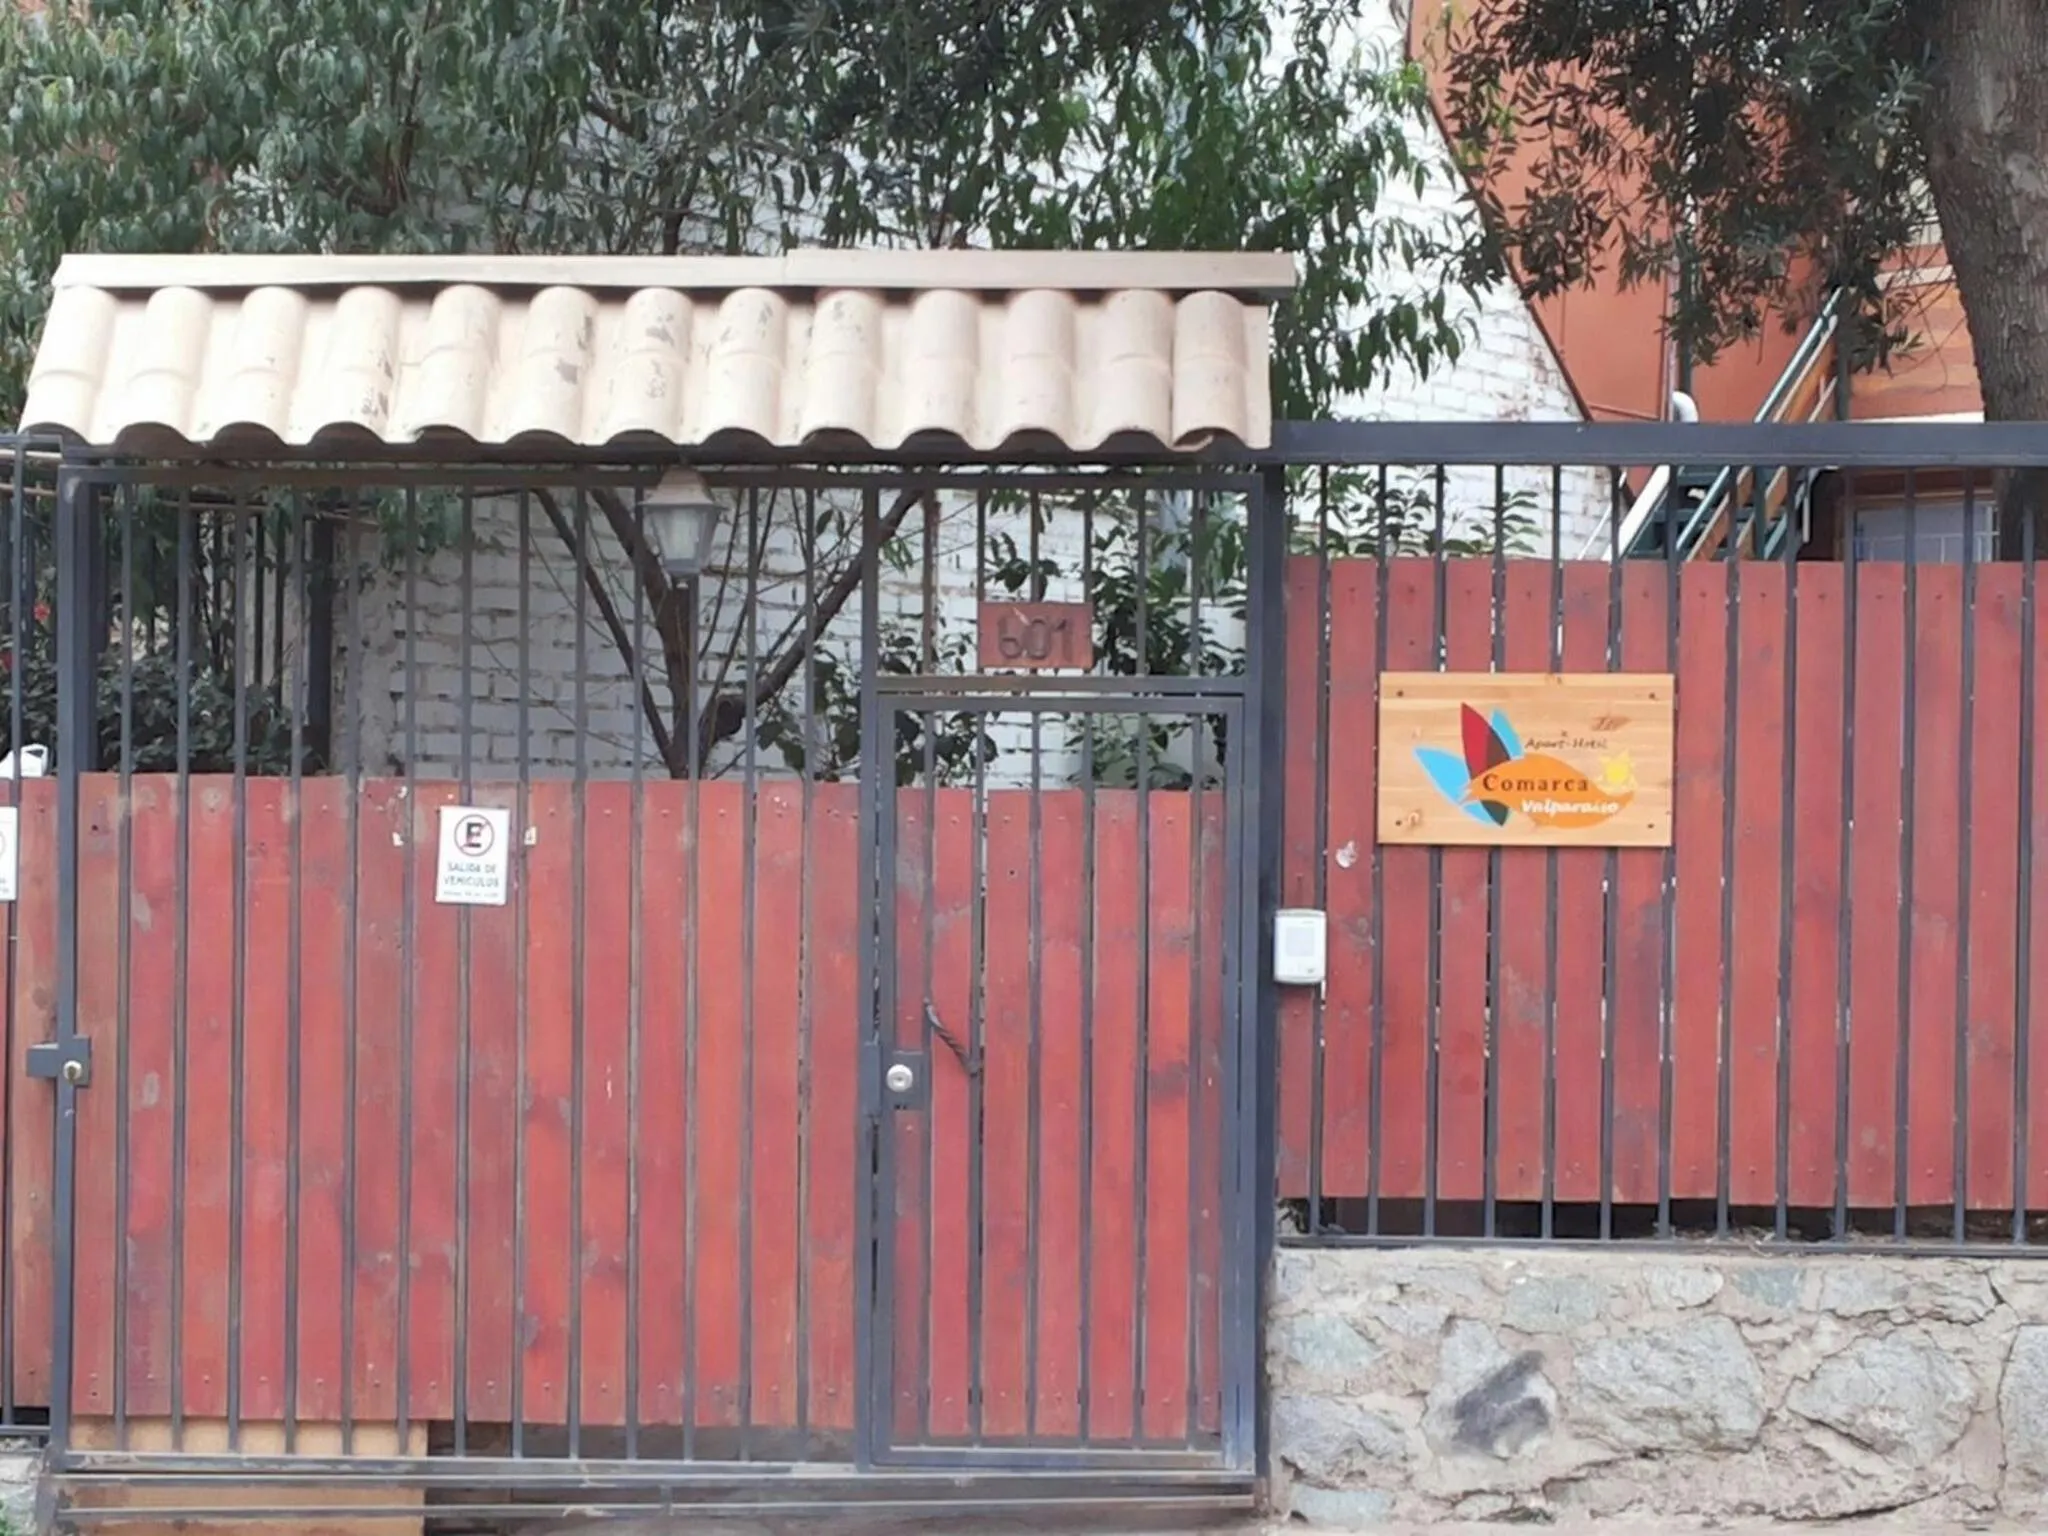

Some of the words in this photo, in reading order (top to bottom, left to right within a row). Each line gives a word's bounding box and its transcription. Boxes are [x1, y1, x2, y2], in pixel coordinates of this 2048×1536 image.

[997, 614, 1074, 661] 601
[1482, 773, 1589, 792] Comarca
[447, 862, 481, 873] SALIDA
[485, 864, 497, 873] DE
